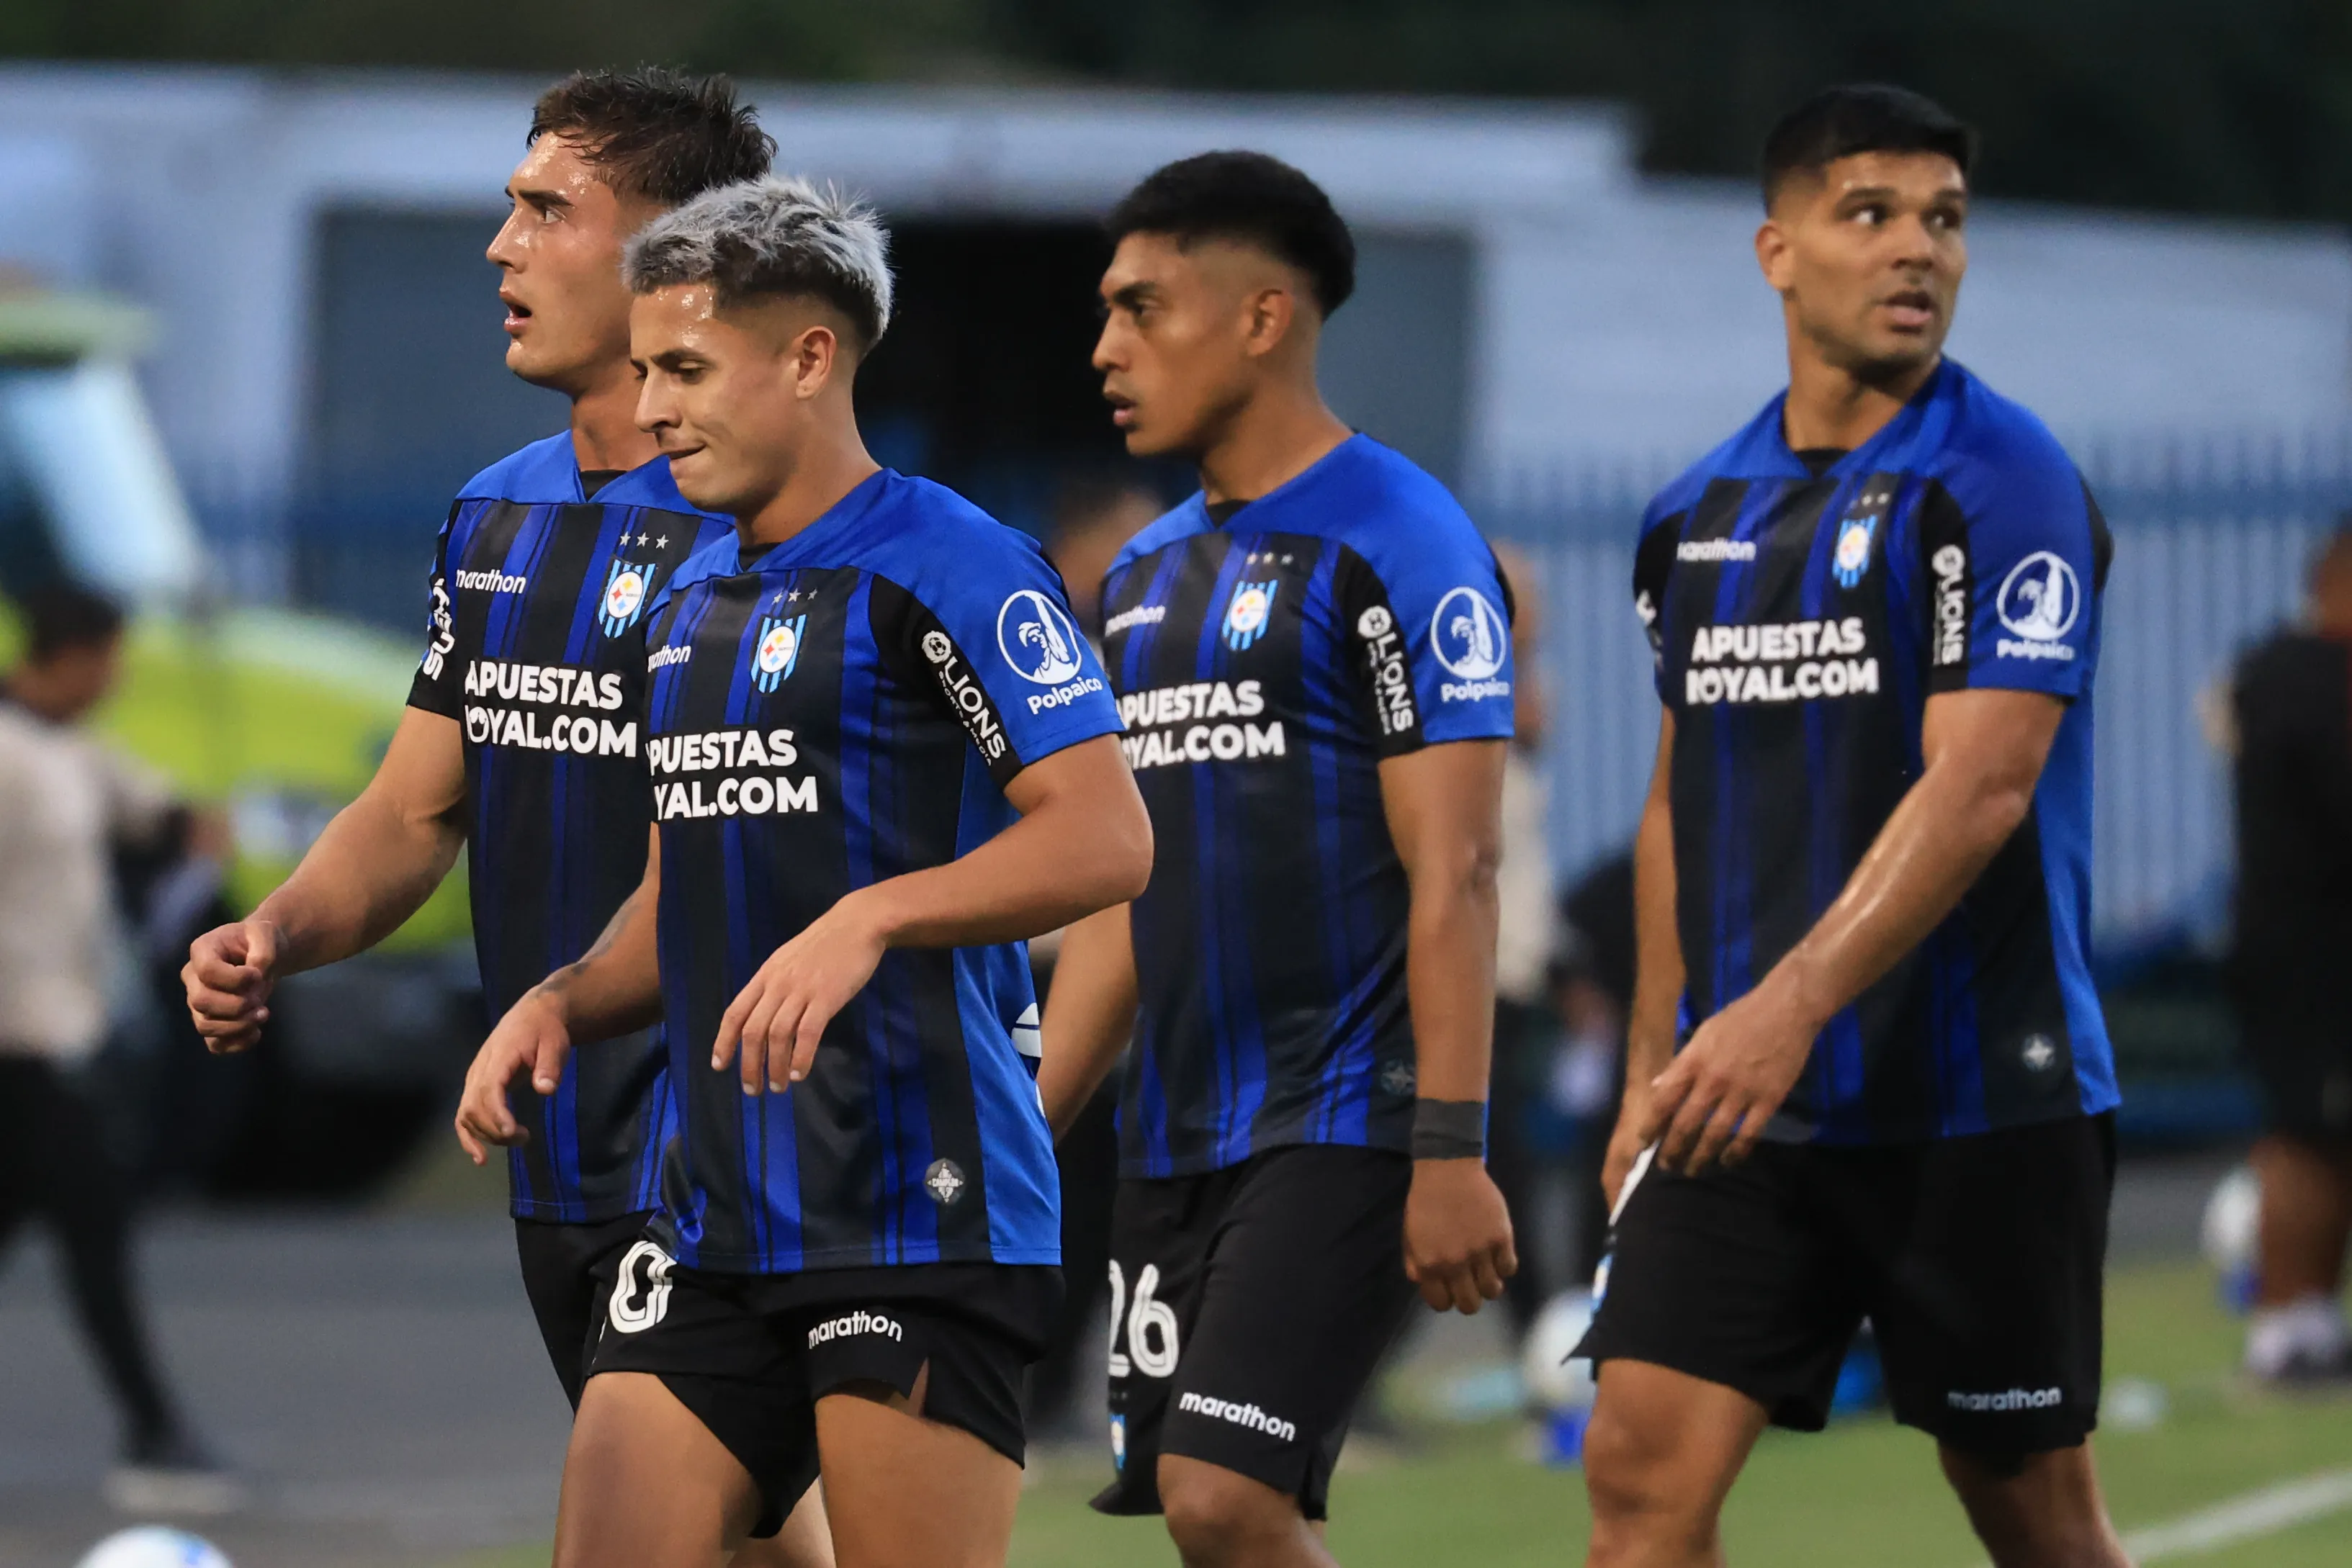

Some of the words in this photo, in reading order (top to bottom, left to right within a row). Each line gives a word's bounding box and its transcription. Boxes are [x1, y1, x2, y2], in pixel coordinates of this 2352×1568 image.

[1690, 616, 1867, 663] APUESTAS
[465, 660, 623, 710] APUESTAS
[1026, 675, 1103, 715] Polpaico
[1377, 631, 1414, 732] LIONS
[464, 705, 637, 758] OYAL.COM
[944, 655, 1006, 759] LIONS
[645, 729, 797, 777] PUESTAS
[653, 775, 818, 821] YAL.COM
[808, 1310, 902, 1350] marathon
[1179, 1392, 1296, 1442] marathon
